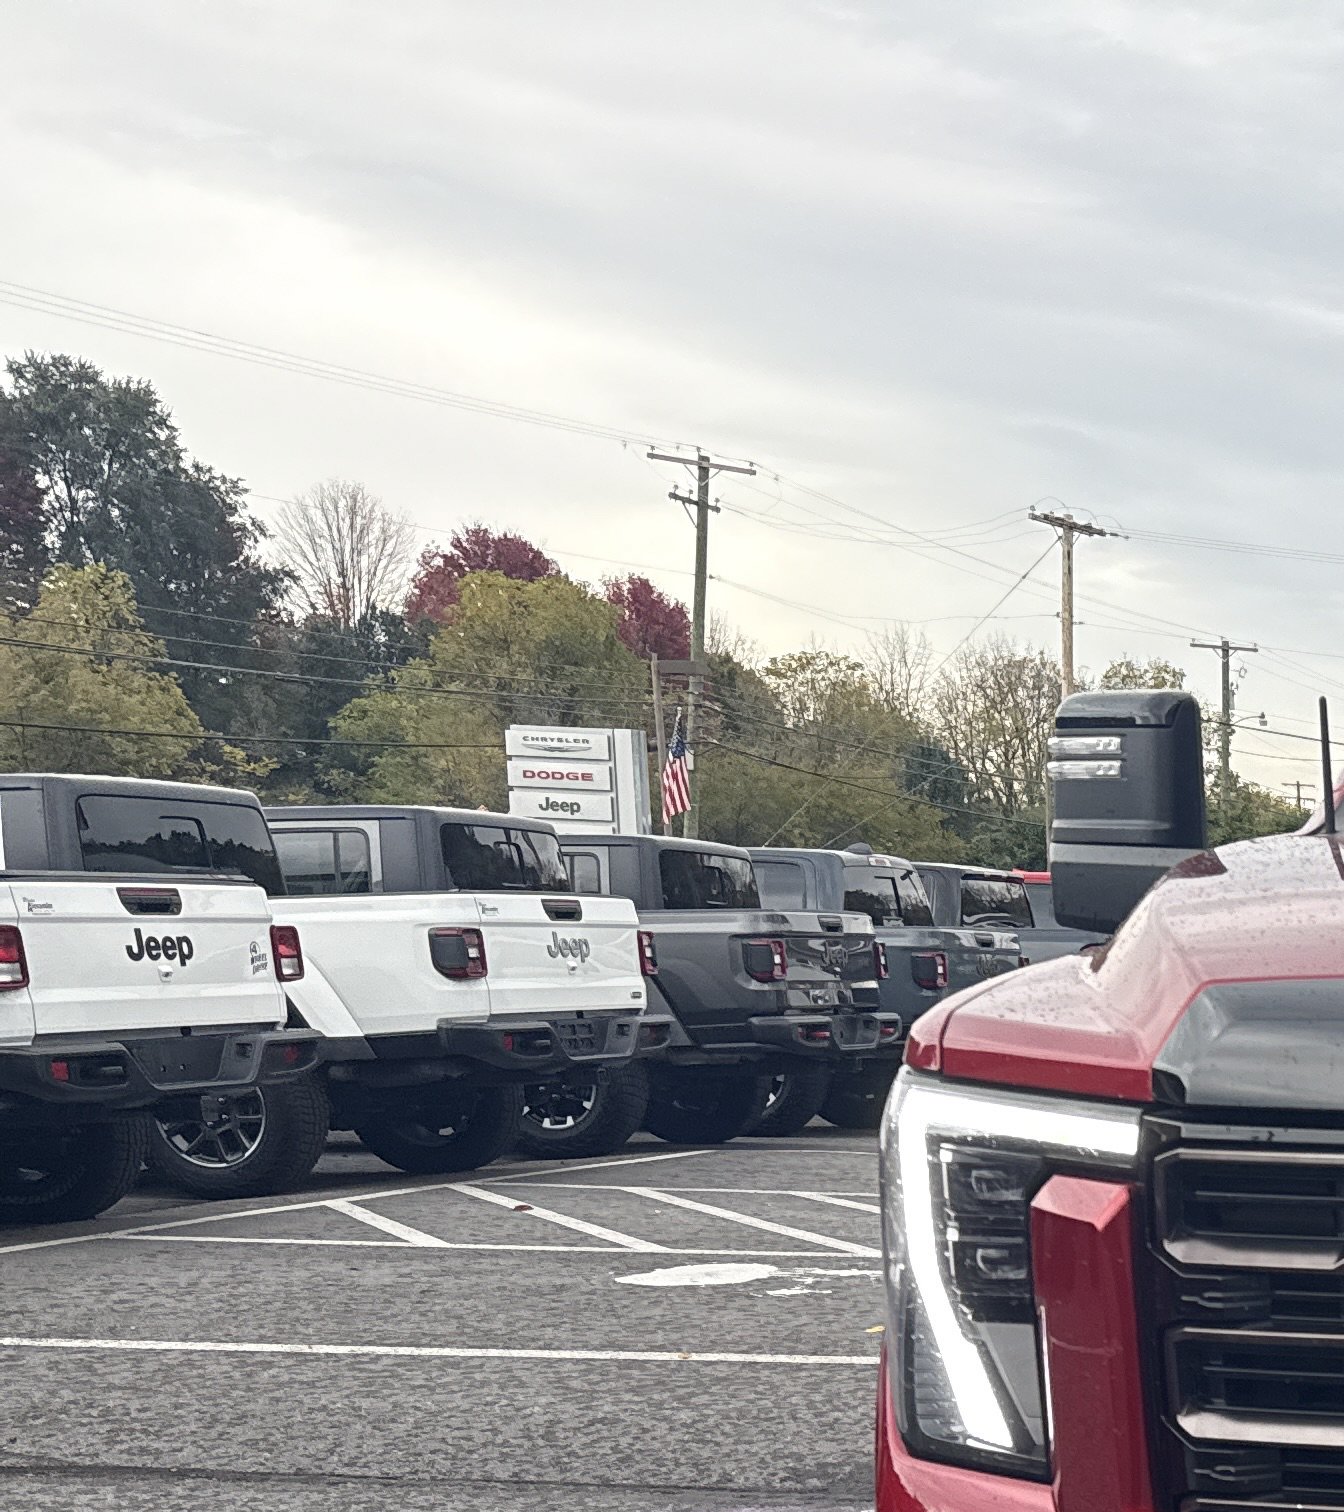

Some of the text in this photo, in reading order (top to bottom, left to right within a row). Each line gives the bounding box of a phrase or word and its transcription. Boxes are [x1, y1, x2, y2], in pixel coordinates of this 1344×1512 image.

[522, 735, 590, 745] CHRYSLER
[522, 769, 594, 782] DODGE
[538, 796, 581, 816] Jeep
[126, 928, 194, 967] Jeep
[546, 931, 591, 964] Jeep
